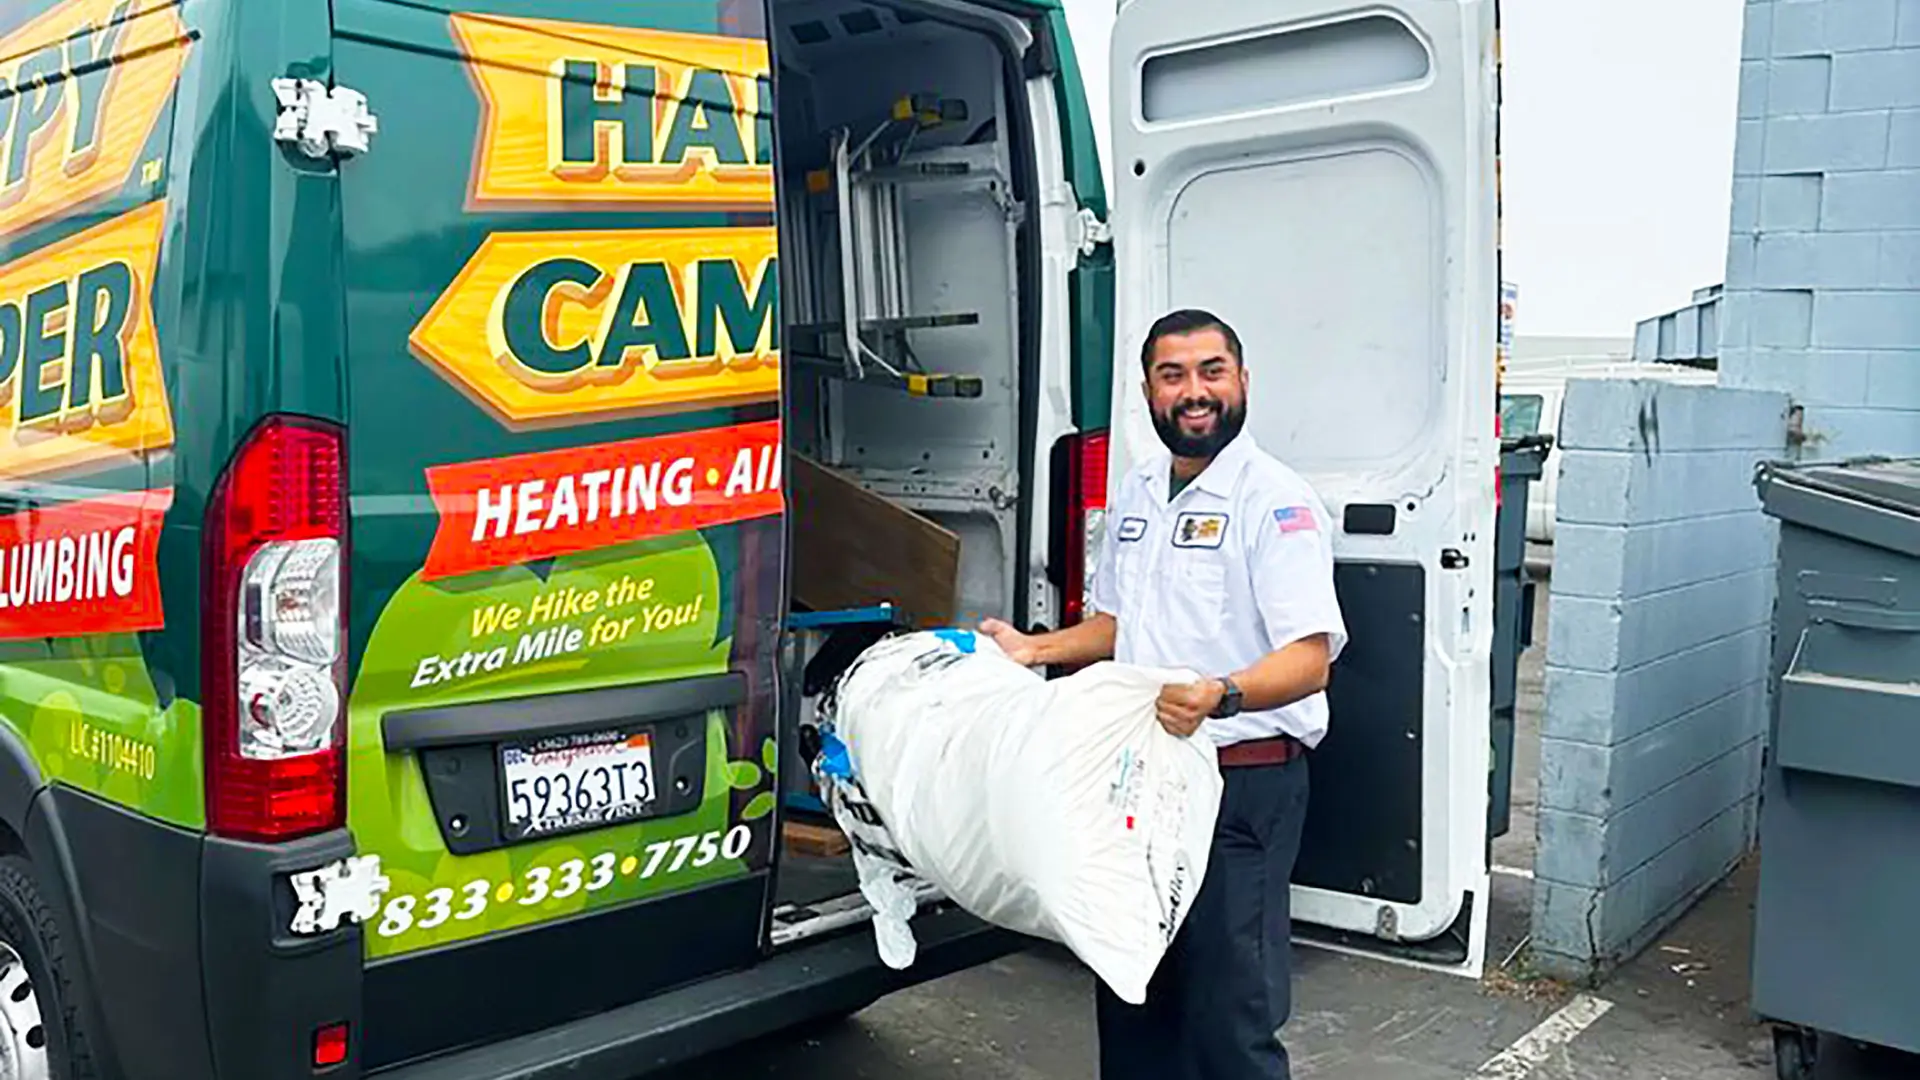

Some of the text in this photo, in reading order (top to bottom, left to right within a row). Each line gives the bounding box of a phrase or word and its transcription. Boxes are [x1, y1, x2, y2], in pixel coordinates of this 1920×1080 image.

[0, 0, 131, 187] PY
[471, 457, 695, 542] HEATING
[410, 595, 703, 688] Extra Mile for You!
[472, 575, 654, 637] We Hike the
[512, 761, 650, 821] 59363T3
